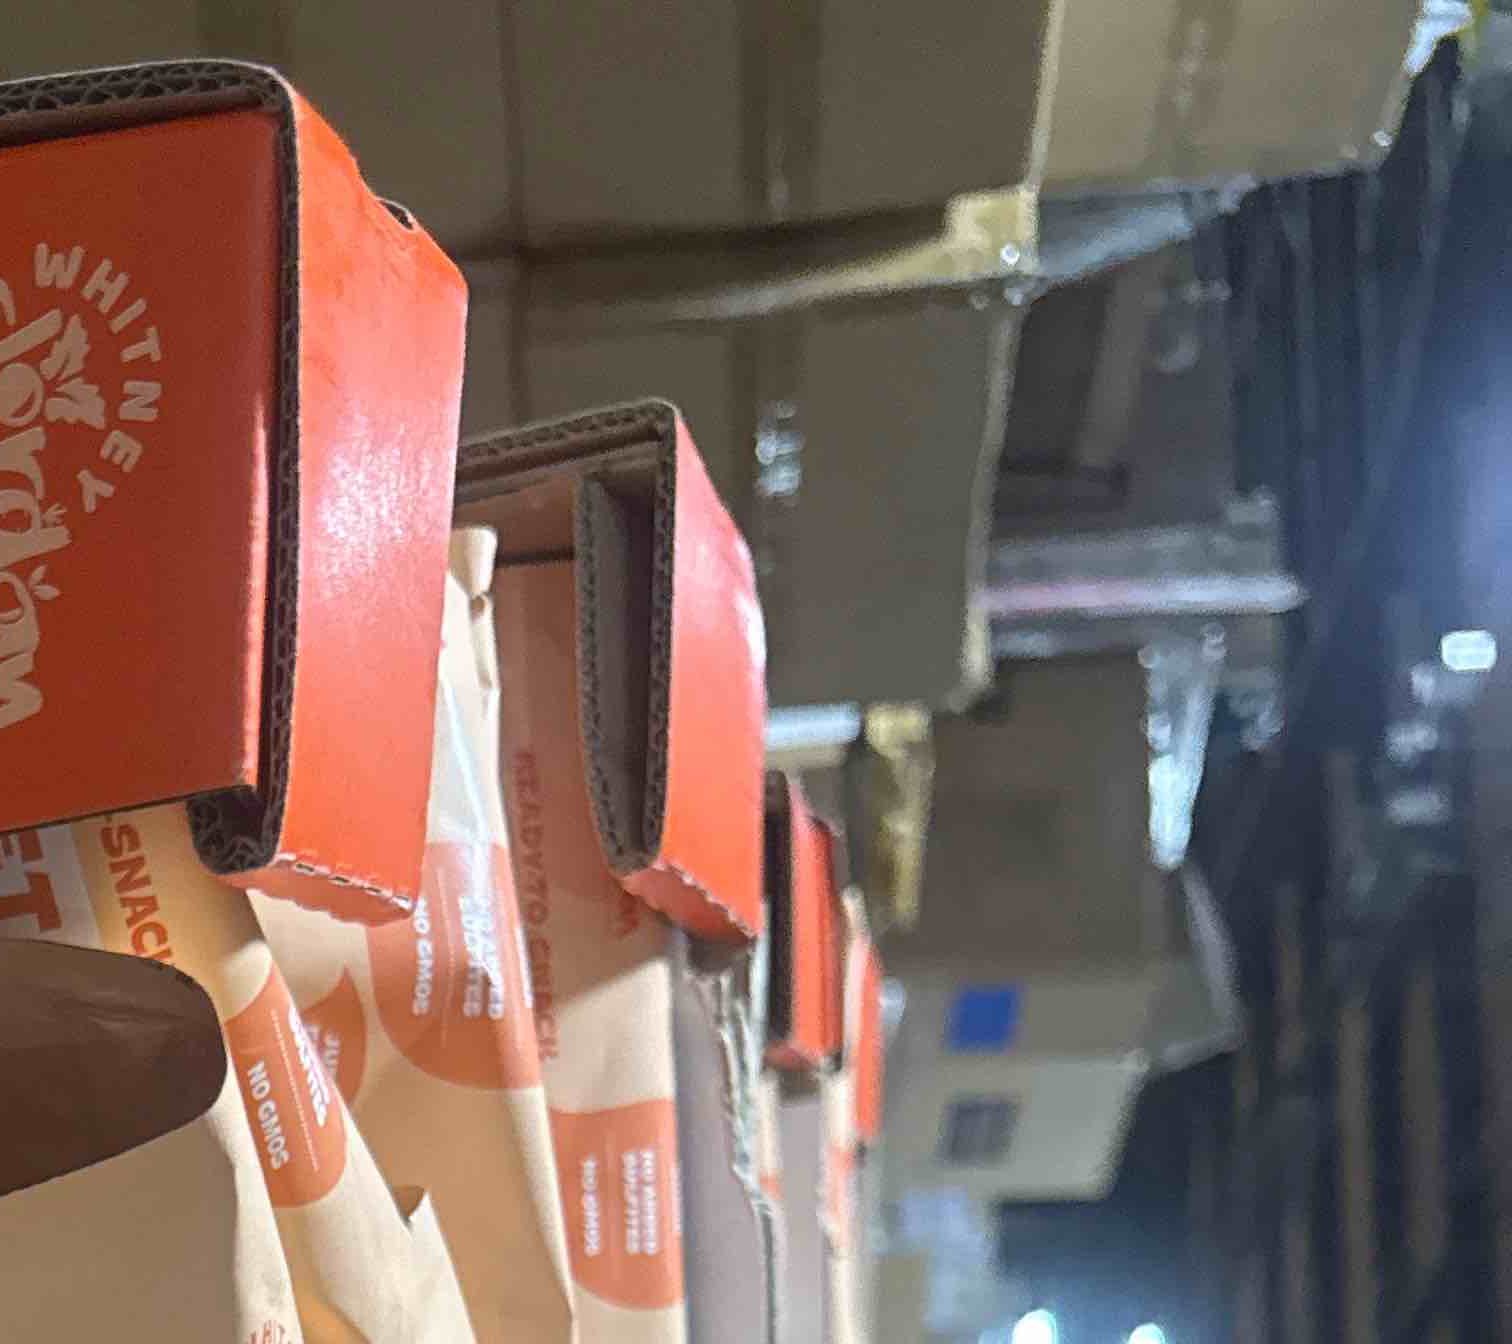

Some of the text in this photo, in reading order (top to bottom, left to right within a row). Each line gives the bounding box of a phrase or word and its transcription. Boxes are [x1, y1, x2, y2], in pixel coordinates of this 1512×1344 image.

[33, 243, 163, 513] WHITNEY
[246, 1061, 291, 1170] NO GMOS
